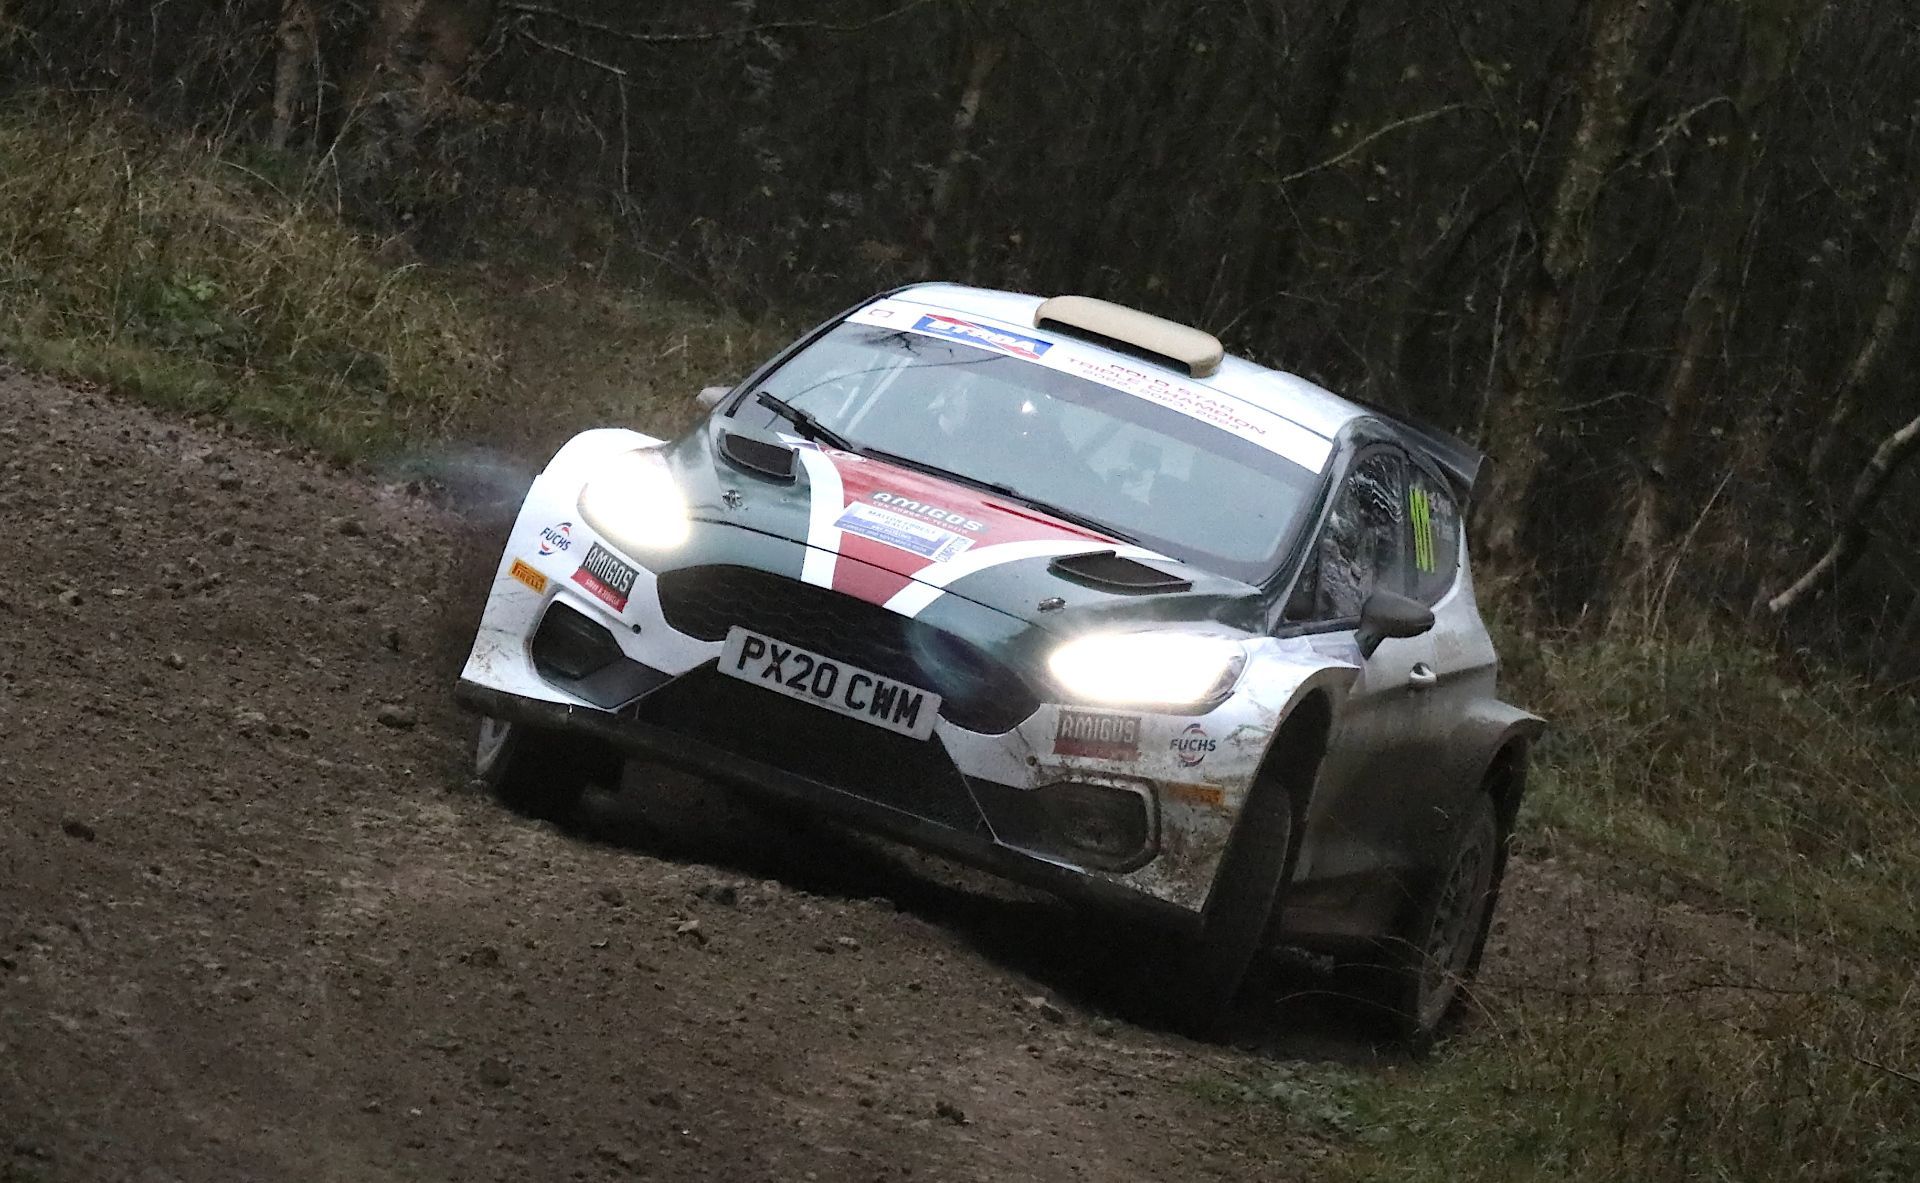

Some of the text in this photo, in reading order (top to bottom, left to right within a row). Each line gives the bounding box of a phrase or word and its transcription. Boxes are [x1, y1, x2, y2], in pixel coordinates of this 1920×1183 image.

[1066, 356, 1267, 435] TRIPLE CHAMPION
[1177, 387, 1235, 413] STAR
[872, 491, 983, 532] AMIGOS
[539, 526, 572, 551] FUCHS
[584, 546, 635, 593] AMIGOS
[736, 635, 924, 730] PX20 CWM
[1169, 738, 1217, 752] FUCHS
